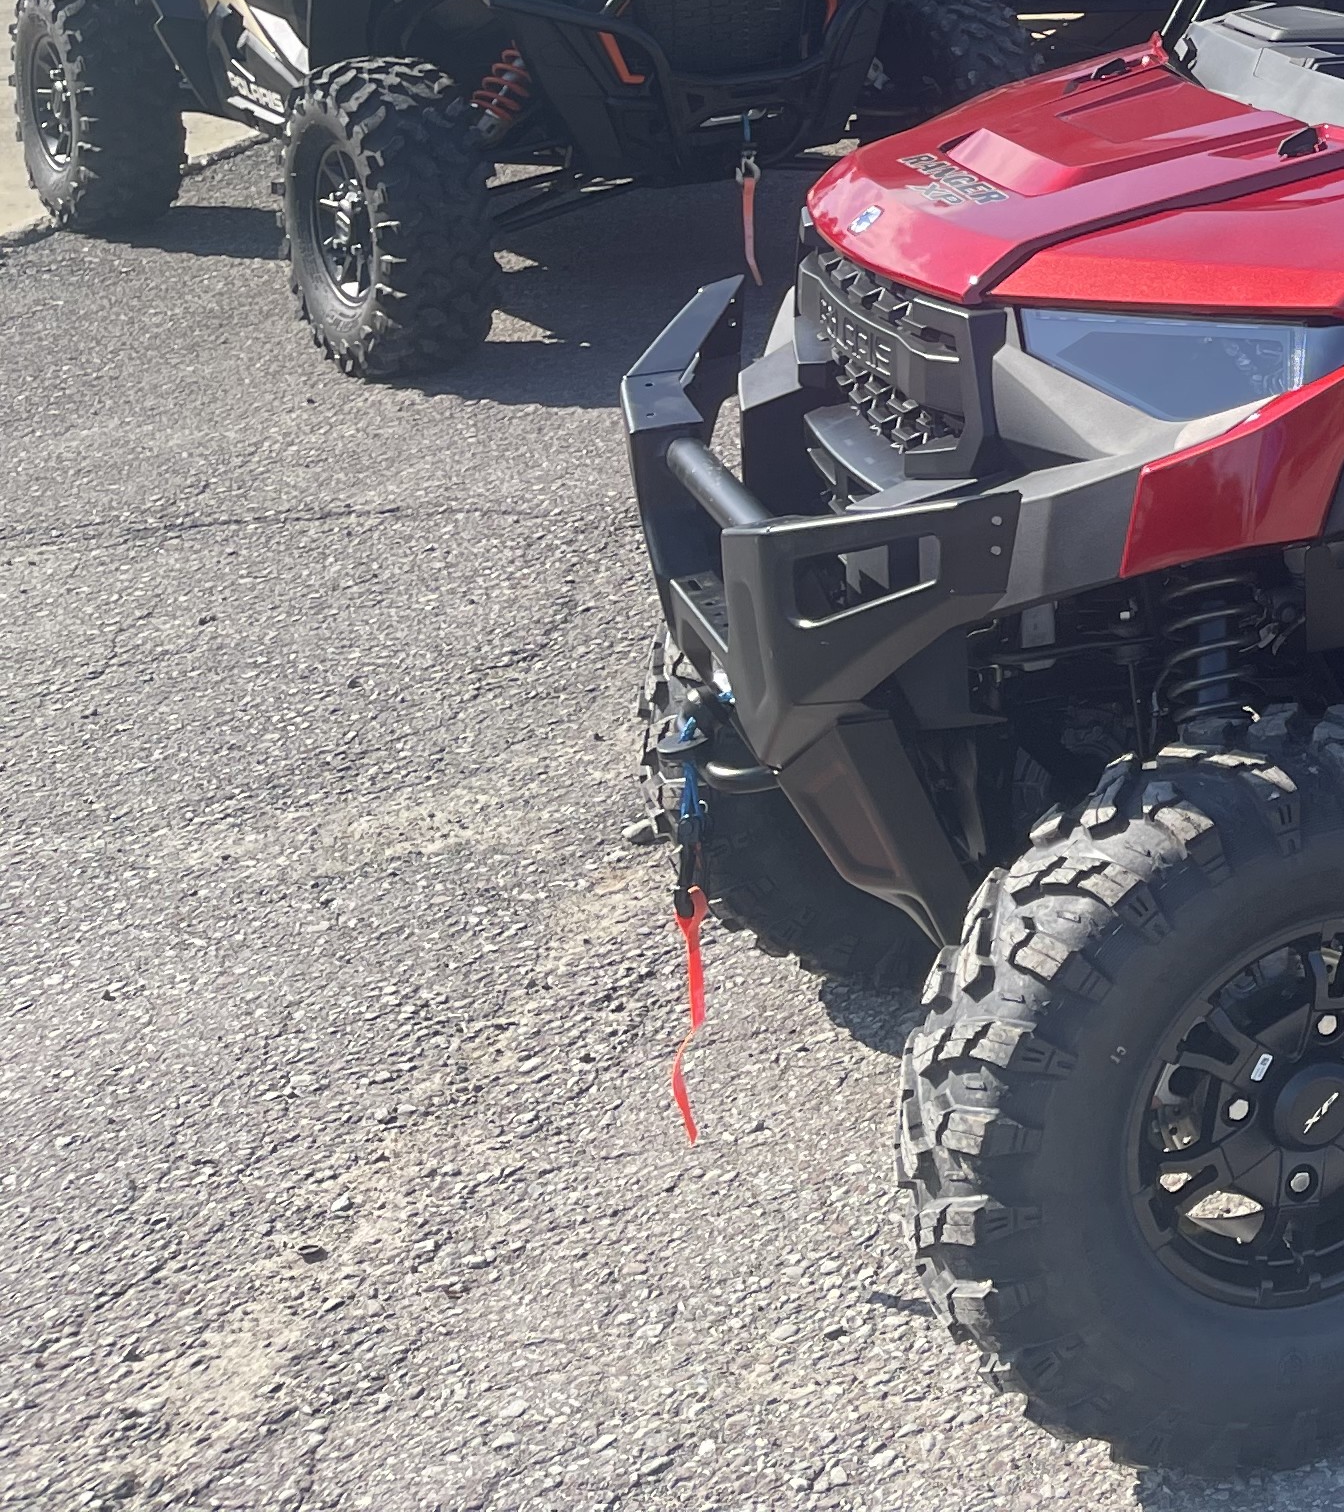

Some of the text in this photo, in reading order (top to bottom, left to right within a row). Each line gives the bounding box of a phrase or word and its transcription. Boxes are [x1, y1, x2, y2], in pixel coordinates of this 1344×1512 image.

[227, 71, 285, 113] POLARIS
[896, 153, 1009, 205] RANGER
[905, 182, 965, 204] XP
